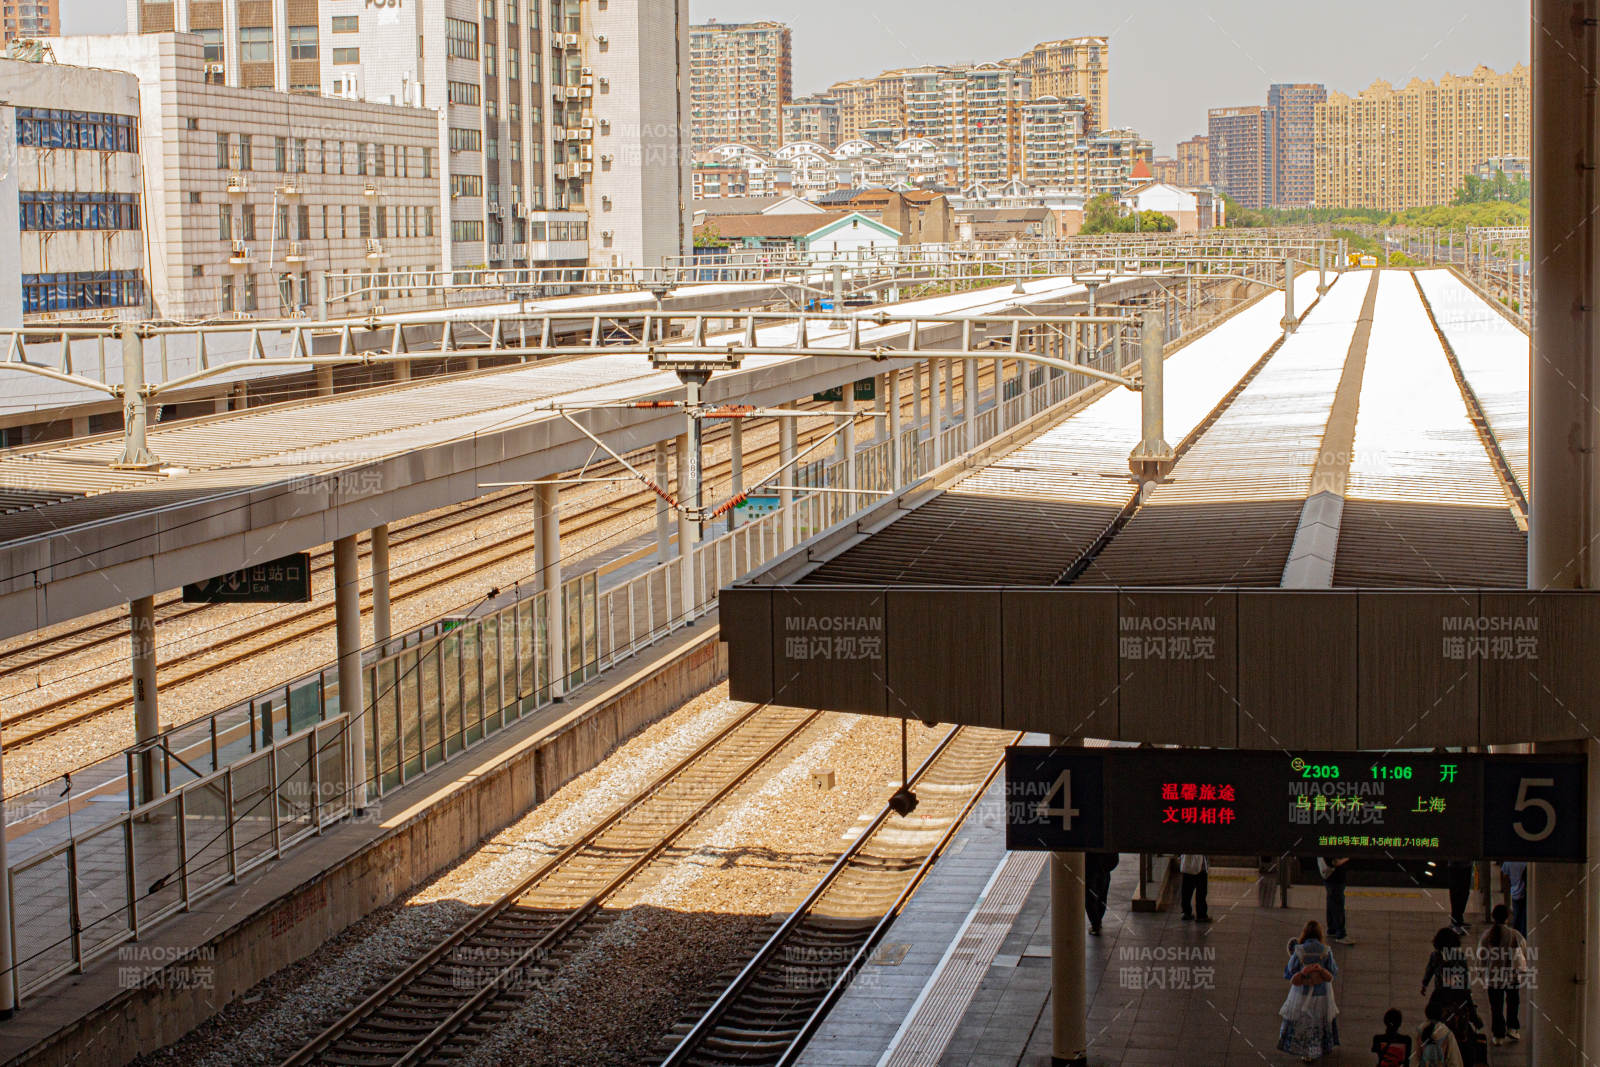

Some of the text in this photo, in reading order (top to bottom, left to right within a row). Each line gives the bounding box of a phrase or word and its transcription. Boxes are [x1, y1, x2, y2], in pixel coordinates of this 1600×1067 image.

[252, 566, 300, 581] 出站口
[253, 584, 270, 592] Exit
[1302, 764, 1459, 783] Z303 11:06 开
[1036, 769, 1080, 831] 4
[1162, 783, 1236, 801] 温馨旅途
[1295, 794, 1365, 811] 乌鲁木齐
[1410, 796, 1447, 813] 上海
[1513, 778, 1556, 841] 5
[1162, 805, 1237, 824] 文明相伴
